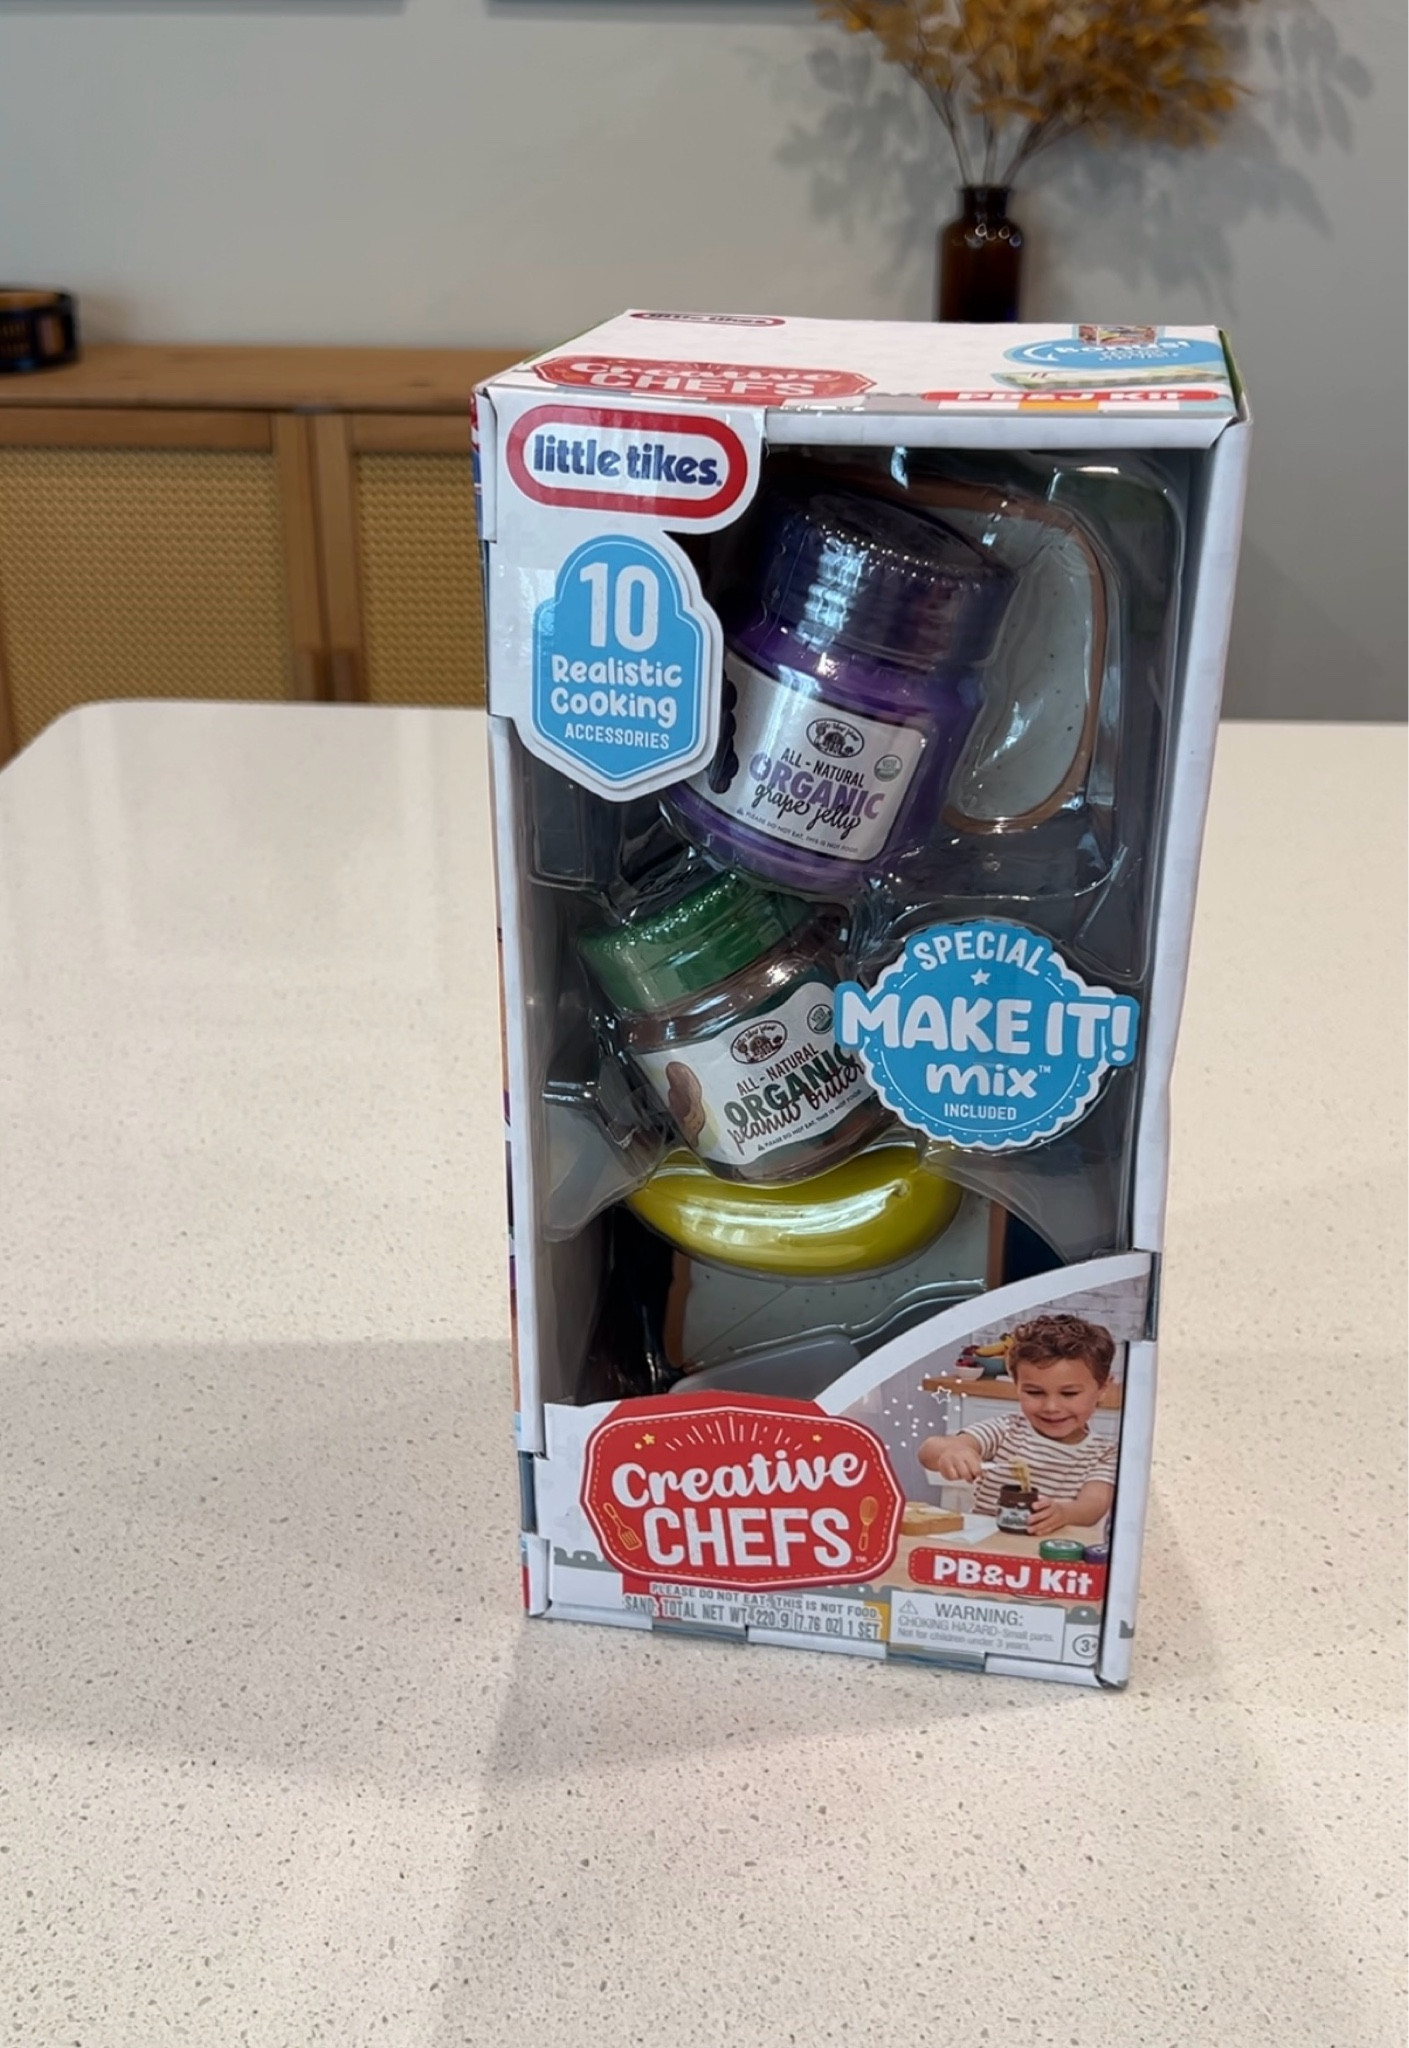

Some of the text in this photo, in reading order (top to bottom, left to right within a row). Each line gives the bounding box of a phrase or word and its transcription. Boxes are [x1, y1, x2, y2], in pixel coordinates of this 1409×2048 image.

[589, 373, 816, 396] CHEFS
[533, 434, 621, 477] little
[579, 562, 659, 653] 10
[551, 655, 682, 688] Realistic
[551, 687, 677, 729] Cooking
[564, 722, 670, 750] ACCESSORIES
[749, 753, 885, 820] ORGANIC
[780, 747, 802, 769] ALL
[812, 759, 867, 788] NATURAL
[751, 782, 862, 840] grape jelly
[913, 931, 1047, 977] SPECIAL
[842, 991, 1032, 1055] MAKE
[1047, 1001, 1132, 1062] IT!
[723, 1043, 856, 1128] ORGANIC
[736, 1076, 760, 1096] ALL
[766, 1042, 820, 1082] NATURAL
[726, 1103, 803, 1156] peanut
[944, 1102, 1017, 1121] INCLUDED
[611, 1448, 869, 1508] Creative
[643, 1506, 853, 1568] CHEFS
[932, 1554, 1093, 1596] PB&J Kit
[623, 1595, 657, 1615] SAND:
[662, 1598, 697, 1619] TOTAL
[702, 1603, 725, 1621] NET
[857, 1622, 881, 1639] SET
[651, 1583, 696, 1598] PLEASE
[698, 1588, 715, 1599] DO
[716, 1591, 739, 1602] NOT
[774, 1596, 803, 1609] THIS
[806, 1601, 817, 1610] IS
[820, 1603, 844, 1614] NOT
[934, 1602, 1025, 1627] WARNING:
[897, 1627, 913, 1637] Not
[915, 1629, 928, 1639] for
[929, 1631, 966, 1644] children
[967, 1635, 995, 1646] under
[996, 1638, 1004, 1648] 3
[898, 1615, 949, 1631] CHOKING
[1002, 1628, 1028, 1640] Small
